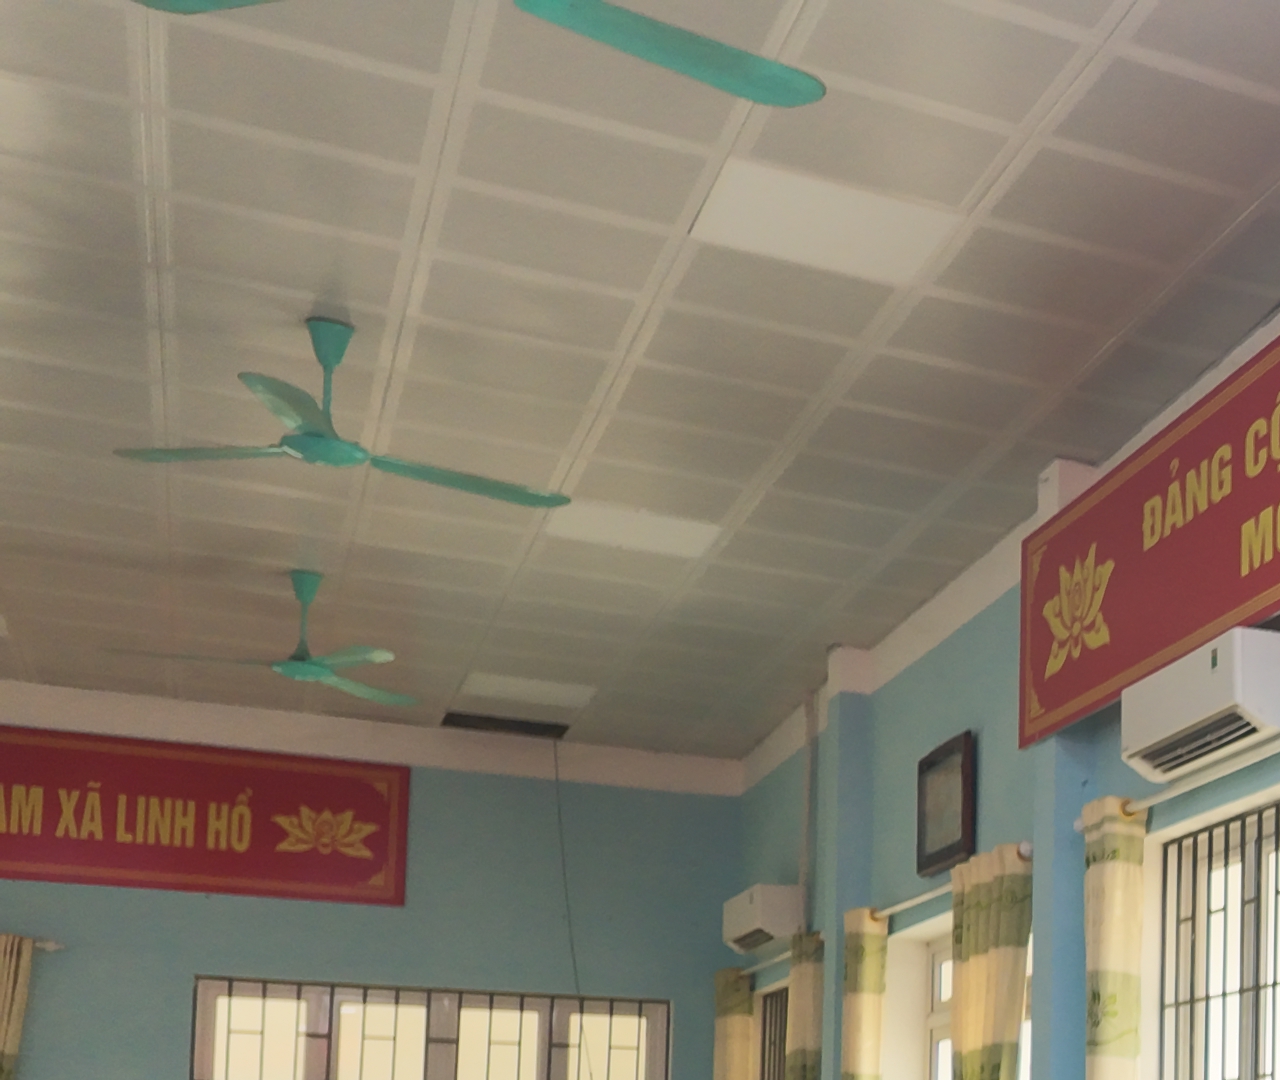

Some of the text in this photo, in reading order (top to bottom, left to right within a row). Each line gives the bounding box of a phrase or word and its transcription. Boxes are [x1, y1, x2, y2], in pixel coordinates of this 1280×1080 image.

[1142, 444, 1232, 551] ĐẢNG
[55, 780, 103, 841] XÃ
[116, 794, 195, 848] LINH
